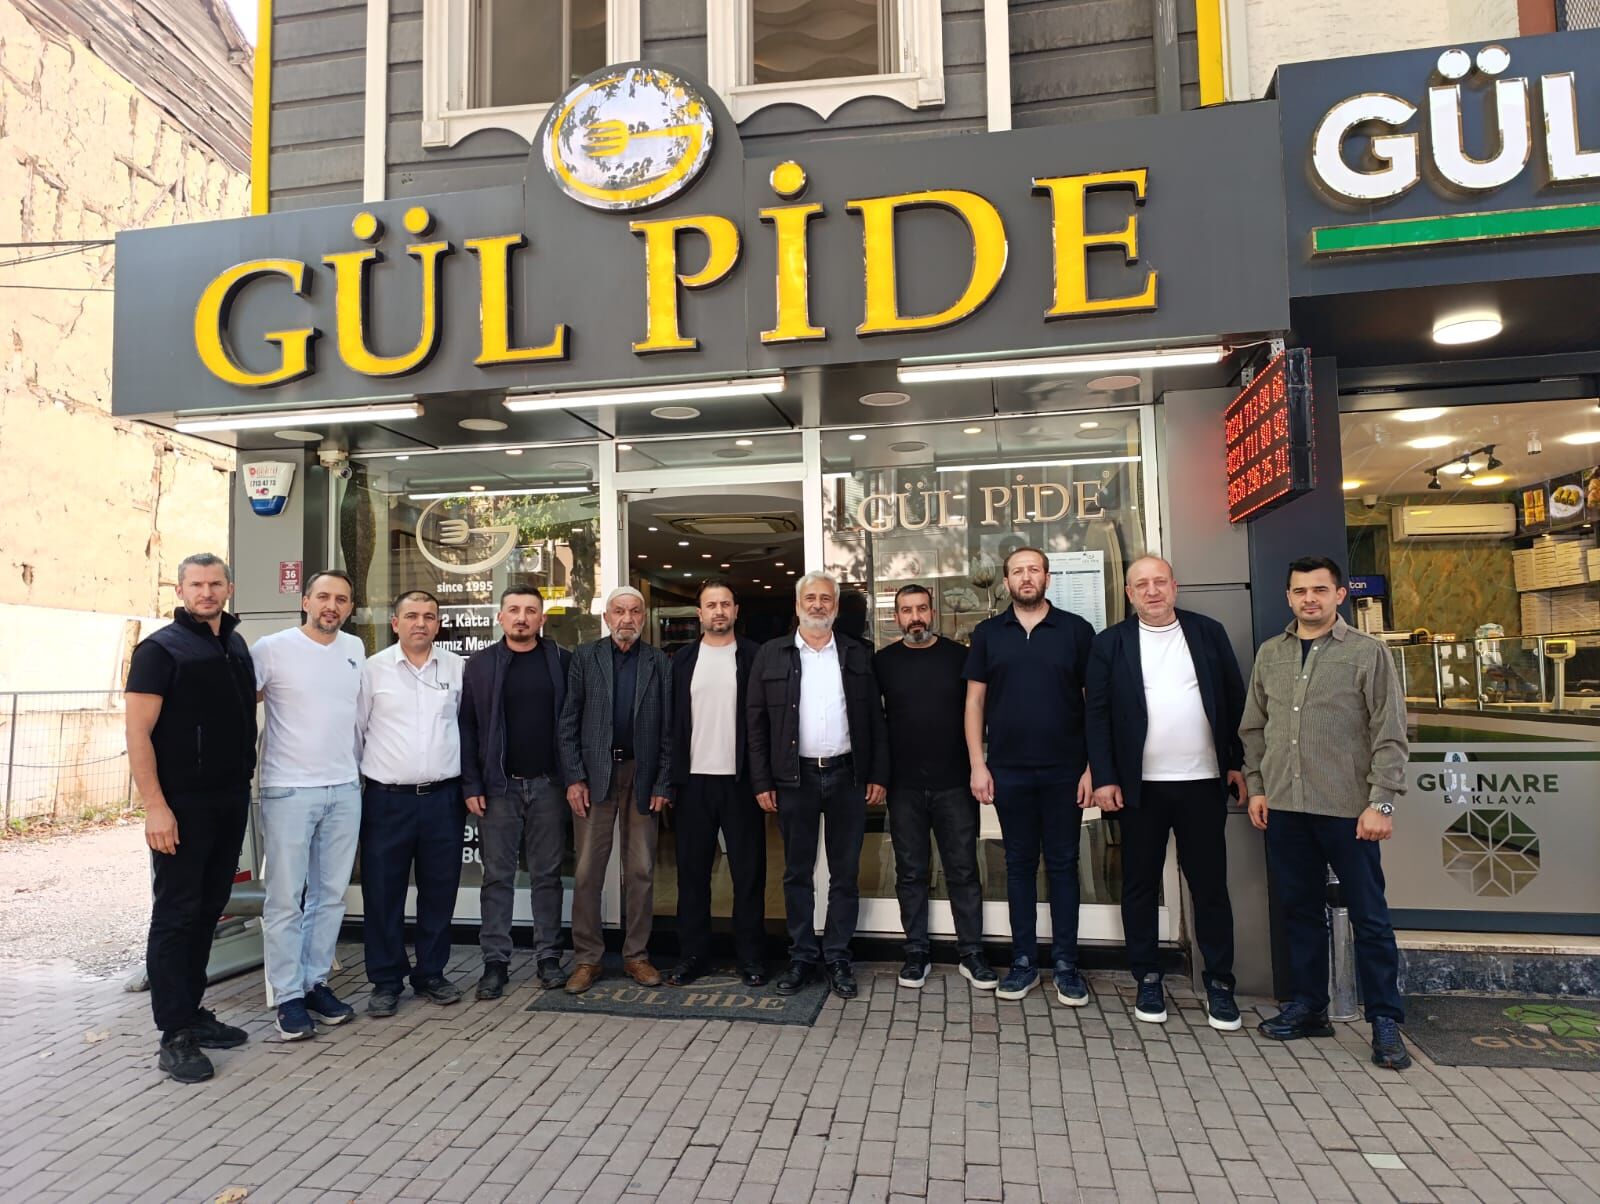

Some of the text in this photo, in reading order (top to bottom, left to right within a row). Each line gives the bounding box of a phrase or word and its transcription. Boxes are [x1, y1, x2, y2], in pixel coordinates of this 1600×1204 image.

[194, 159, 1159, 388] GÜL PİDE
[857, 474, 1106, 533] GÜL PİDE
[285, 570, 296, 579] 36
[437, 581, 494, 593] since 1995
[441, 613, 453, 628] 2.
[455, 613, 490, 628] Katta
[1416, 768, 1559, 793] GÜLNARE
[1444, 794, 1536, 805] BAKLAVA
[576, 985, 787, 1011] GÜL PİDE
